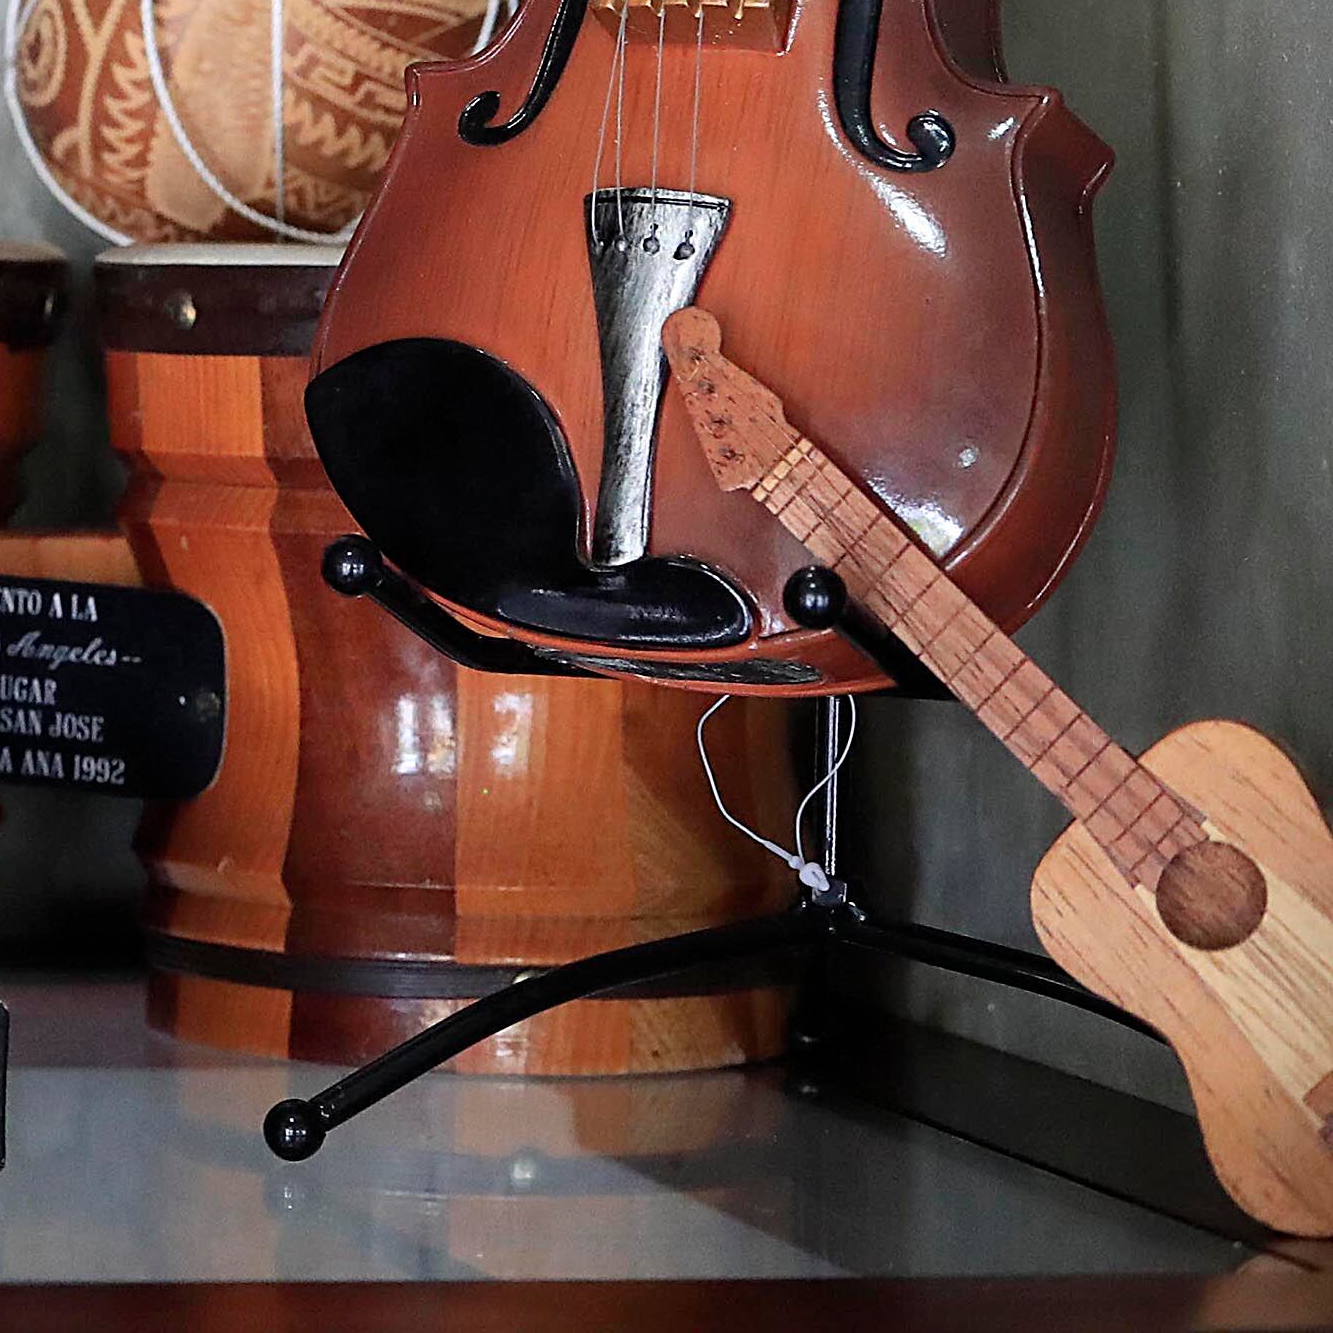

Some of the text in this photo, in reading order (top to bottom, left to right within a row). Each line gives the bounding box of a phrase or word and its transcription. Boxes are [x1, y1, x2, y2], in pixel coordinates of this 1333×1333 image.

[48, 592, 64, 618] A
[71, 593, 98, 623] LA
[49, 711, 105, 743] JOSE
[21, 749, 65, 779] ANA
[73, 754, 126, 785] 1992
